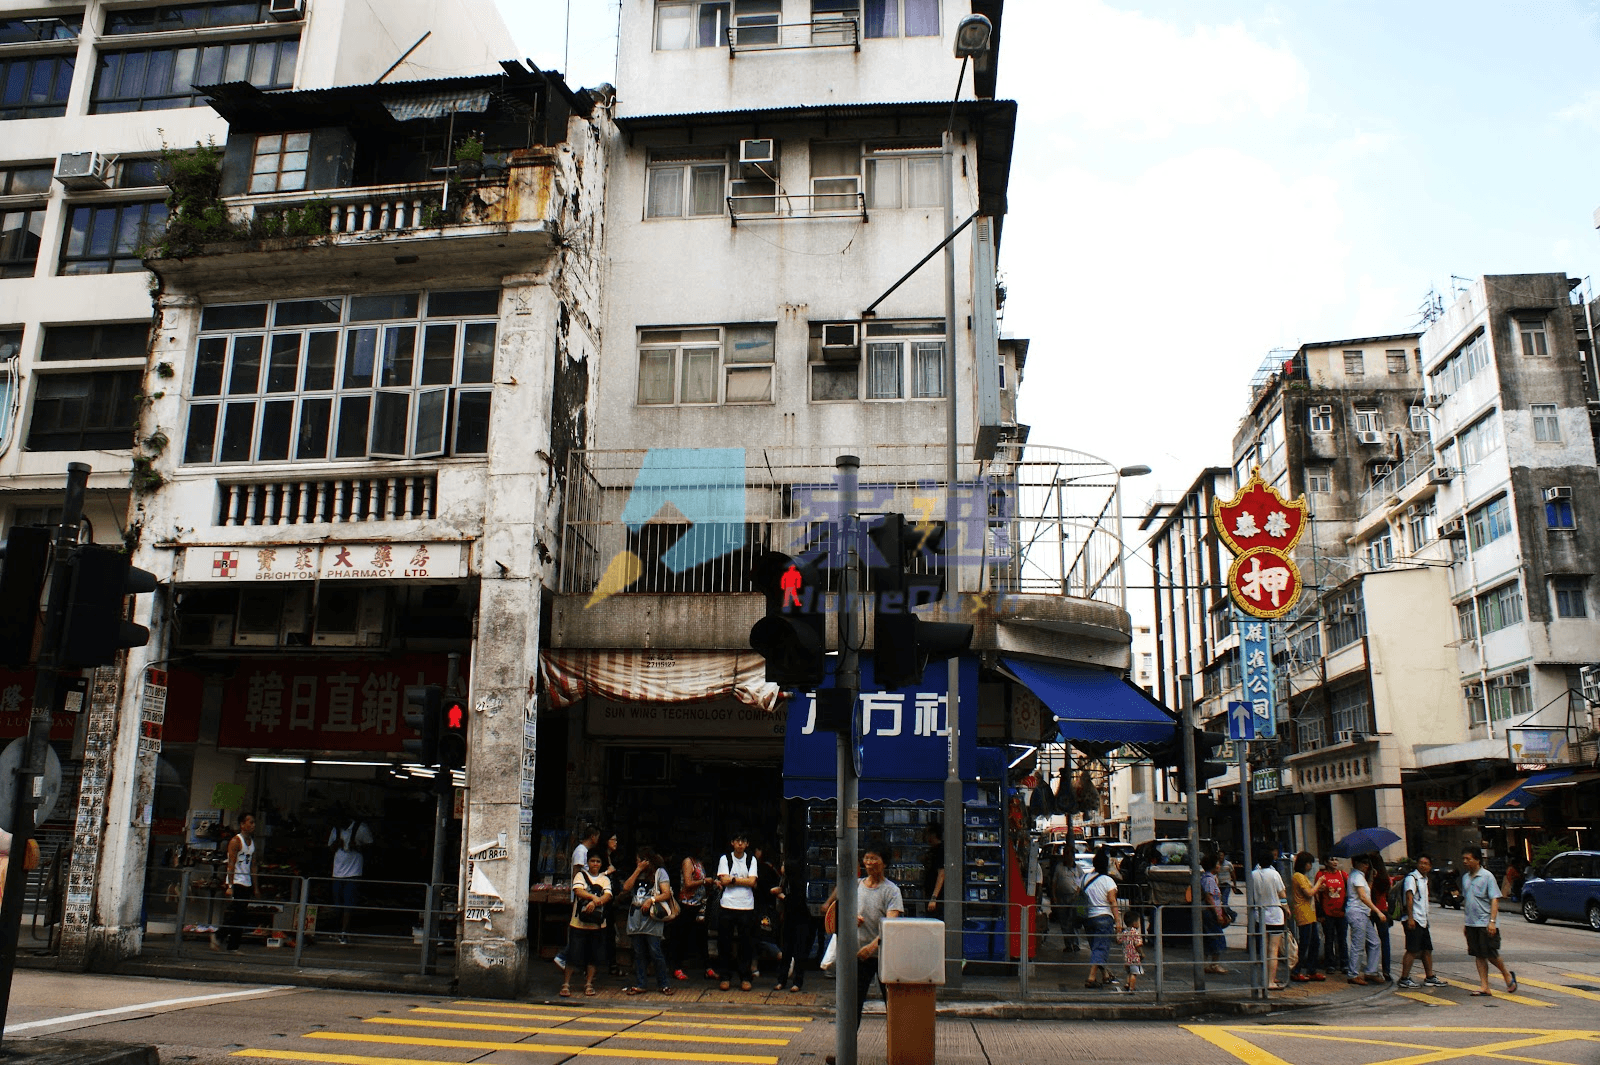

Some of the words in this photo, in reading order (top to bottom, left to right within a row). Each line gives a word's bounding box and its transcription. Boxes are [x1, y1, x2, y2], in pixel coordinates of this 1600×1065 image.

[255, 571, 316, 580] BRIGHTON
[327, 569, 395, 578] PHARMACY
[404, 569, 429, 577] LTD.
[1240, 557, 1291, 608] 押
[155, 687, 166, 698] 8819
[244, 669, 467, 735] 韓日直銷中
[152, 711, 164, 723] 8819
[605, 707, 625, 719] SUN
[631, 707, 657, 719] WING
[662, 707, 732, 720] TECHNOLOGY
[738, 709, 788, 721] COMPANY
[802, 690, 960, 737] 方社
[52, 717, 75, 727] AN
[149, 739, 161, 751] 8819
